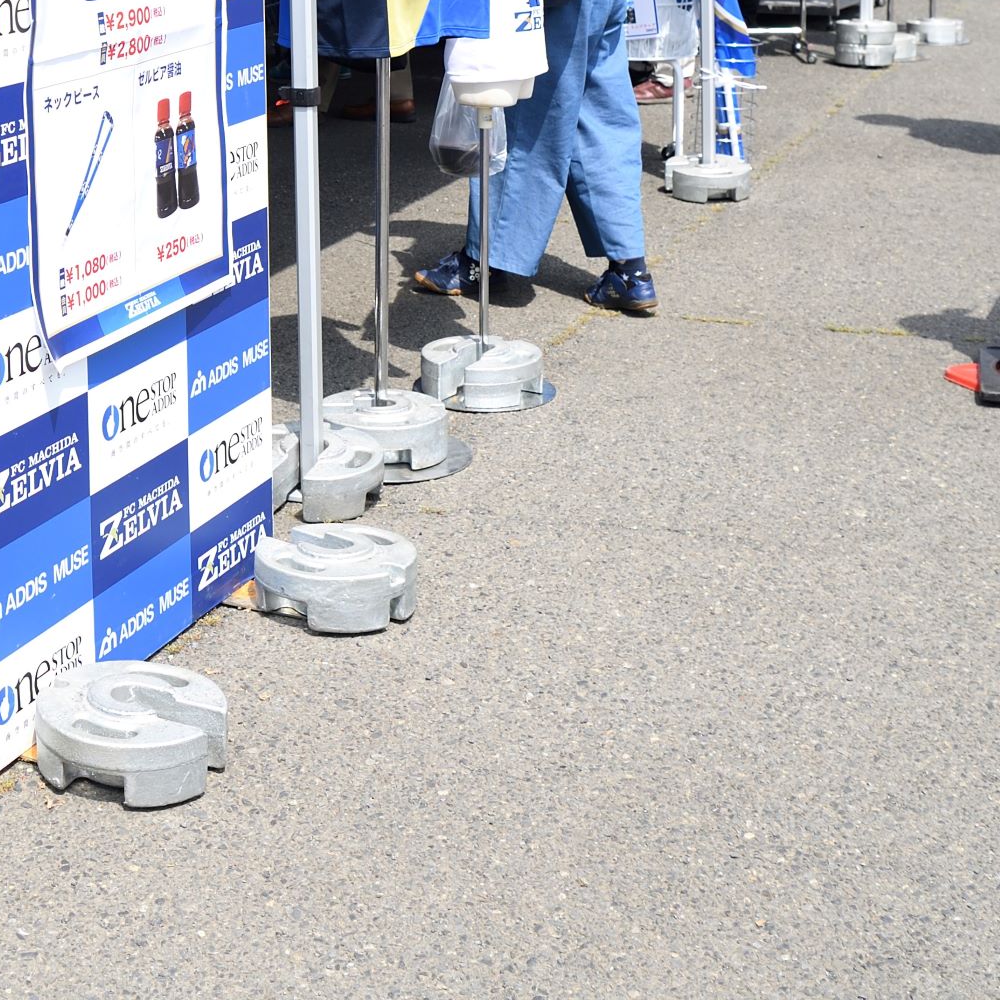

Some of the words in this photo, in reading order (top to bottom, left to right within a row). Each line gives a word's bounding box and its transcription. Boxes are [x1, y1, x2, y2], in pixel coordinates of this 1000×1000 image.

[44, 84, 100, 114] ネックピース
[207, 355, 240, 389] ADDIS
[242, 338, 270, 369] MUSE
[150, 371, 178, 401] STOP
[151, 393, 178, 417] ADDIS
[10, 461, 27, 477] FC
[28, 432, 80, 470] MACHIDA
[122, 502, 137, 517] FC
[138, 475, 181, 510] MACHIDA
[99, 493, 184, 561] ZELVIA
[5, 570, 48, 616] ADDIS
[53, 544, 90, 585] MUSE
